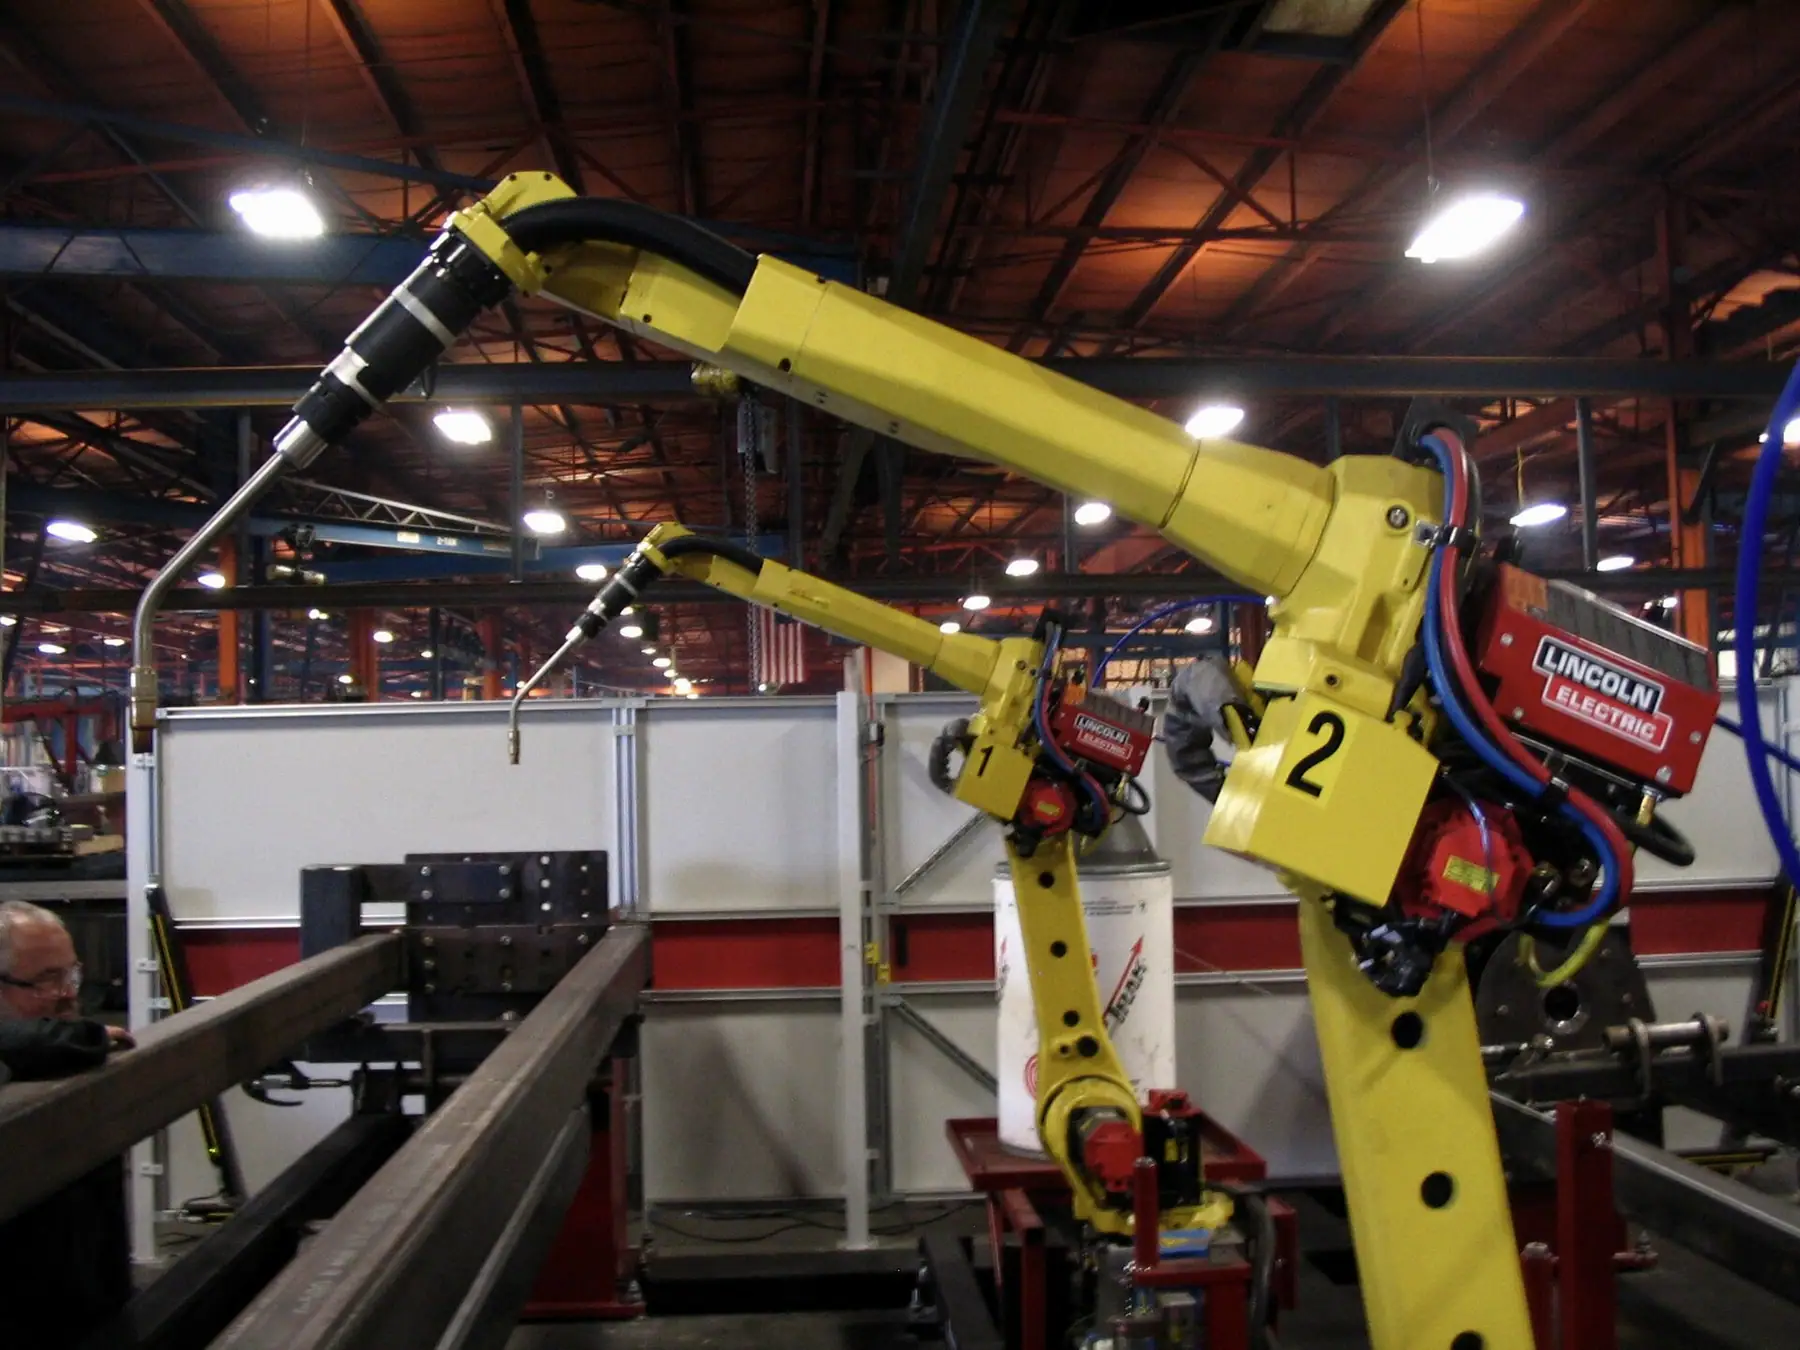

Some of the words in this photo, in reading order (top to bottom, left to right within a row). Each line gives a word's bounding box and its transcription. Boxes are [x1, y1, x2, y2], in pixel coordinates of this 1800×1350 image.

[1542, 646, 1654, 711] LINCOLN
[1078, 716, 1126, 743] LINCOLN
[1555, 685, 1658, 740] ELECTRIC
[977, 746, 994, 778] 1
[1285, 710, 1345, 798] 2
